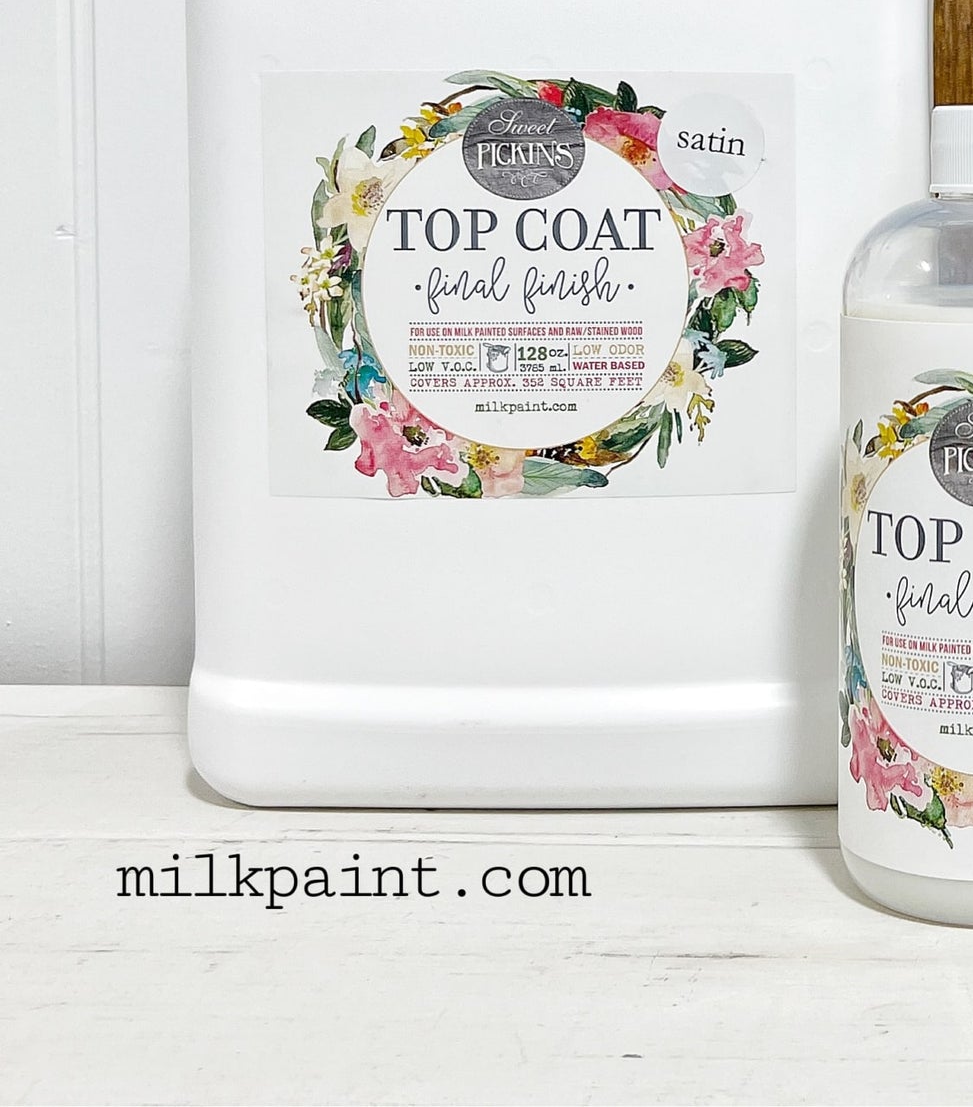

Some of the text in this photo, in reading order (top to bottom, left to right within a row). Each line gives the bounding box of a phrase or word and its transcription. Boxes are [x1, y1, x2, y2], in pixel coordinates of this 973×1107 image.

[488, 109, 557, 136] Sweet
[677, 127, 745, 157] satin
[477, 140, 574, 170] PICKINS
[386, 208, 661, 252] TOP COAT
[427, 256, 620, 314] final finish
[410, 327, 643, 337] FOR USE ON MILK PAINTED SURFACES AND RAW/STAINED WOOD
[409, 344, 474, 356] NON-TOXIC
[518, 347, 568, 361] 128 oz.
[573, 344, 644, 355] LOW ODOR
[409, 362, 477, 372] LOW V.O.C.
[520, 364, 566, 373] 3785 ml.
[573, 361, 645, 370] WATER BASED
[410, 377, 642, 388] COVERS APPROX. 352 SQUARE FEET
[475, 401, 578, 414] milkpaint.com
[867, 510, 963, 563] TOP
[882, 635, 894, 646] FOR
[895, 637, 907, 648] USE
[908, 639, 918, 650] ON
[919, 641, 937, 652] MILK
[939, 643, 971, 655] PAINTED
[882, 653, 939, 673] NON-TOXIC
[882, 672, 942, 690] LOW V.O.C.
[882, 689, 923, 705] COVERS
